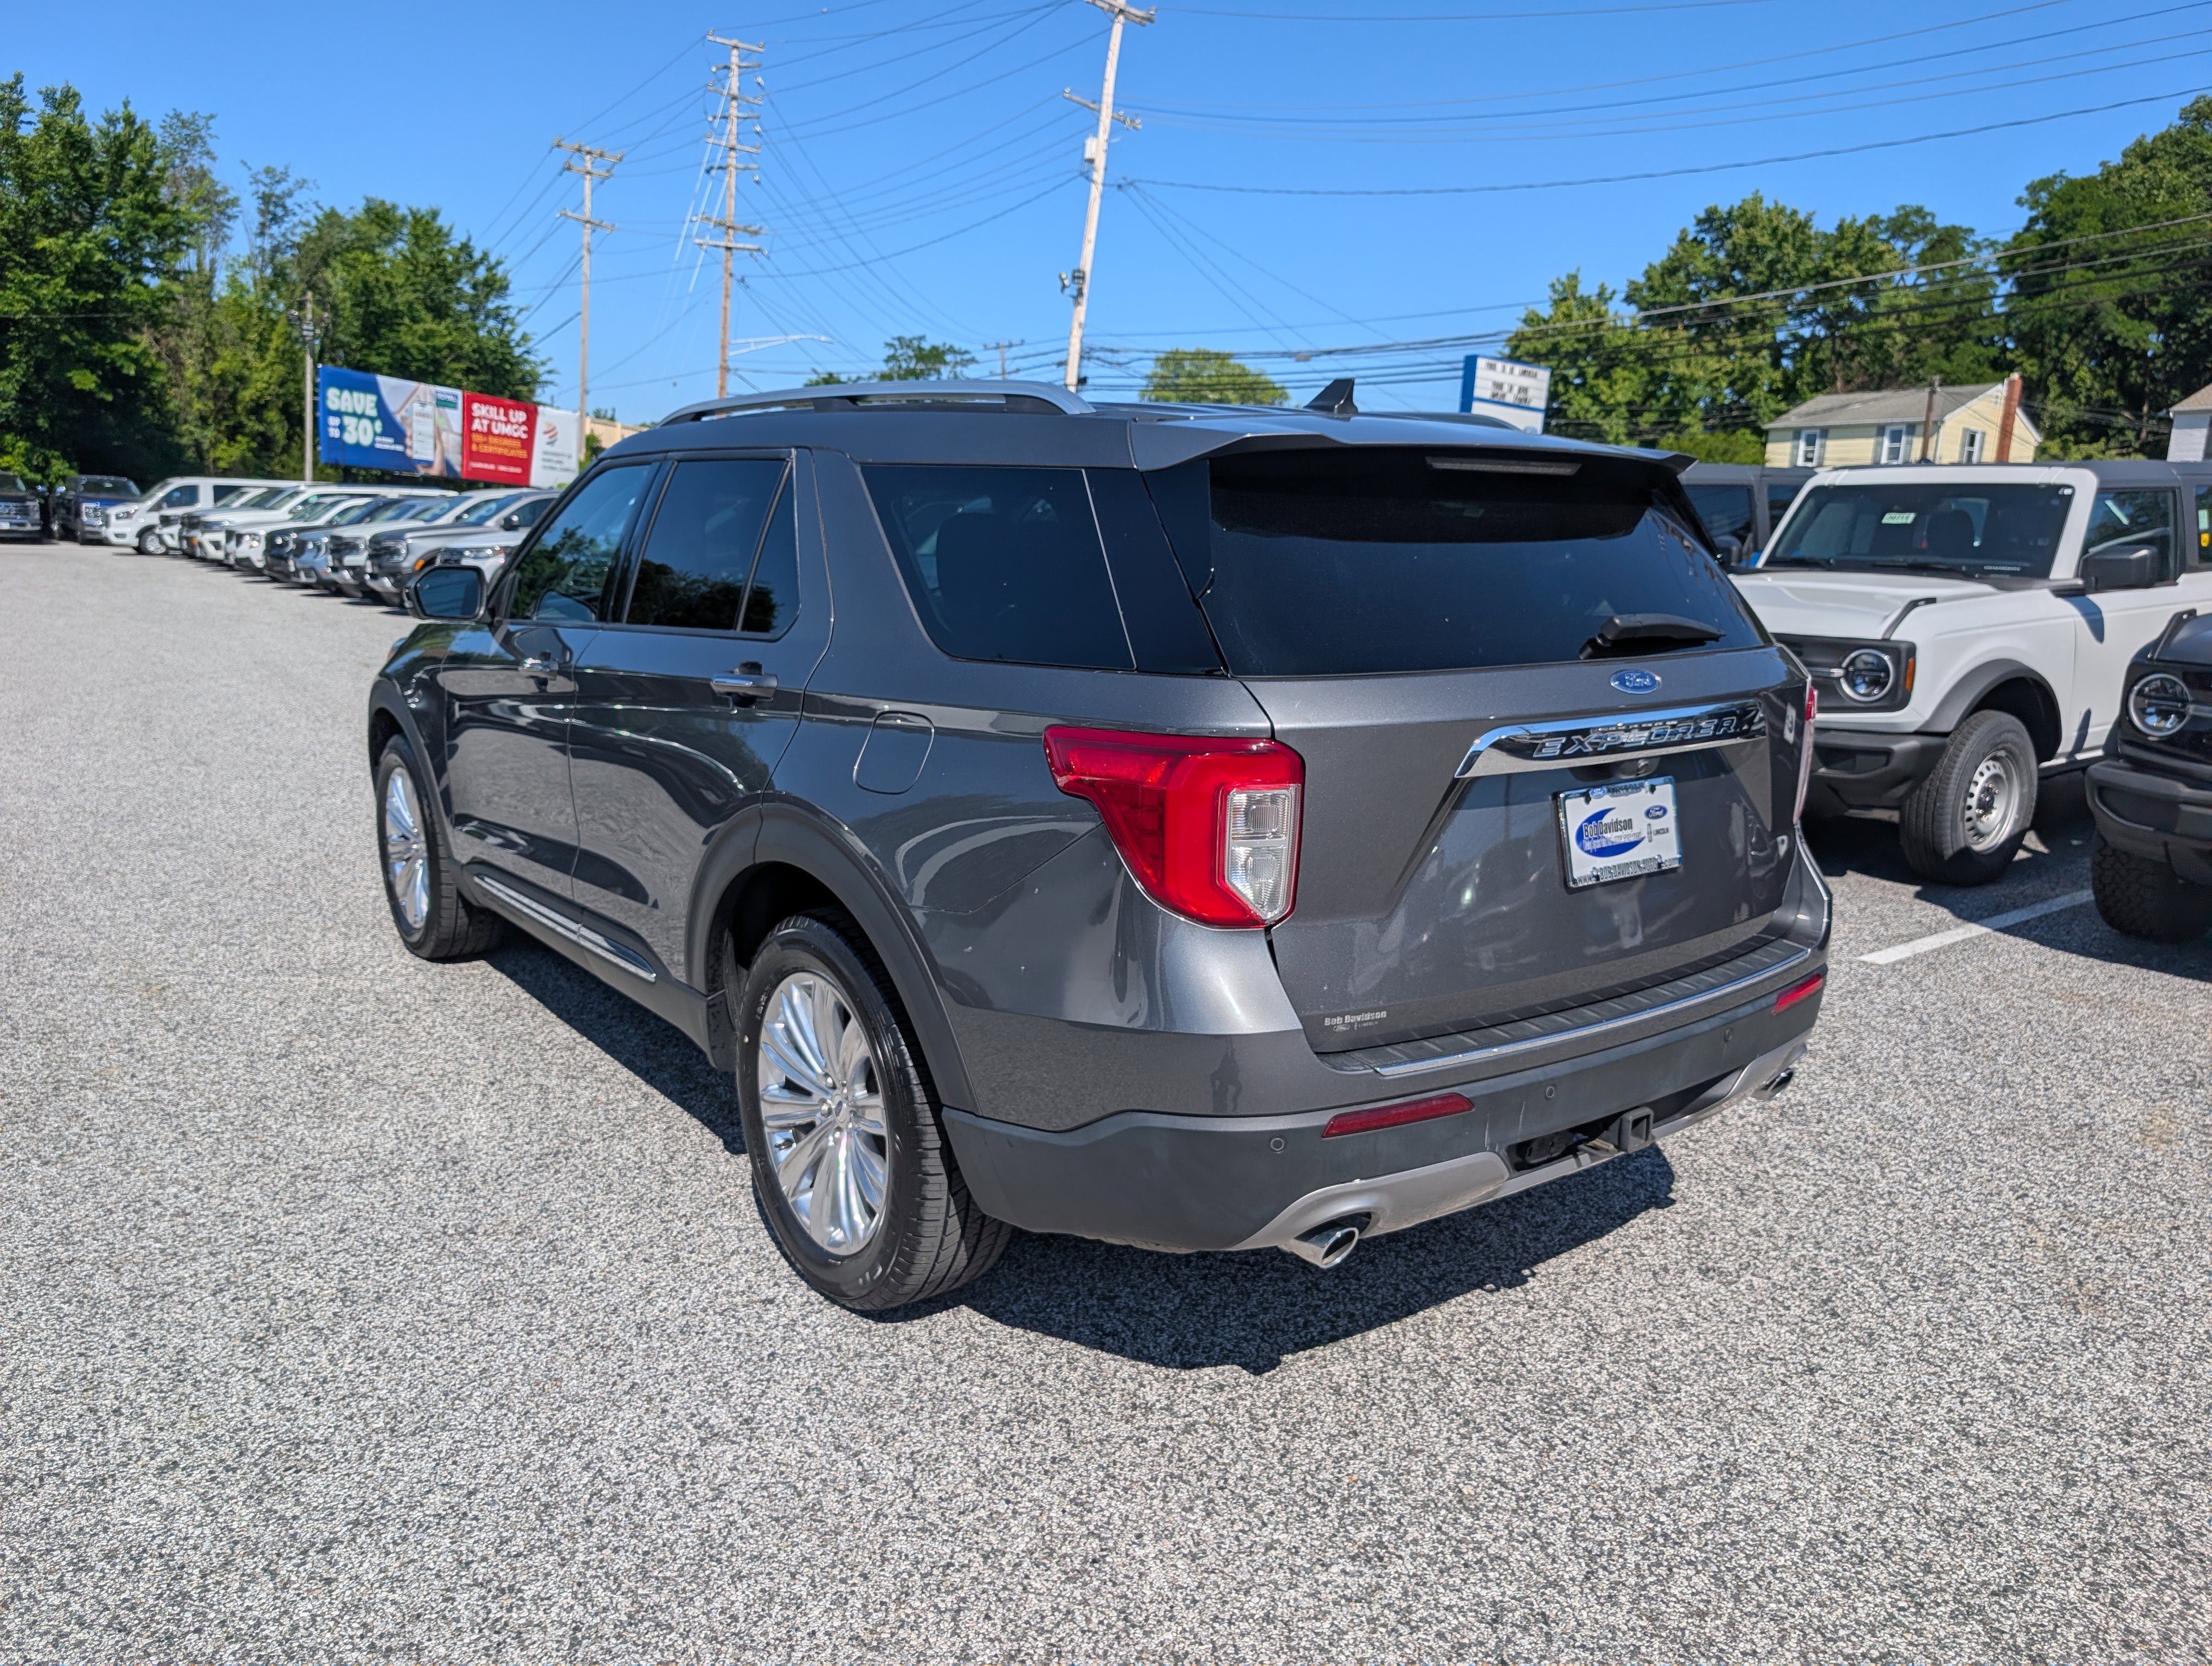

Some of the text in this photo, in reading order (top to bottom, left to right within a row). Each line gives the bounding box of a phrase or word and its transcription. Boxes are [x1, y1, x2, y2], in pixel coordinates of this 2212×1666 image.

[326, 387, 377, 416] SAVE
[471, 402, 508, 421] SKILL
[509, 408, 527, 424] UP
[471, 418, 490, 433] AT
[491, 420, 529, 439] UMGC
[1533, 715, 1739, 757] EXPLORER
[1583, 818, 1632, 838] Bob Davidson
[1324, 1010, 1387, 1026] Bob Davidson
